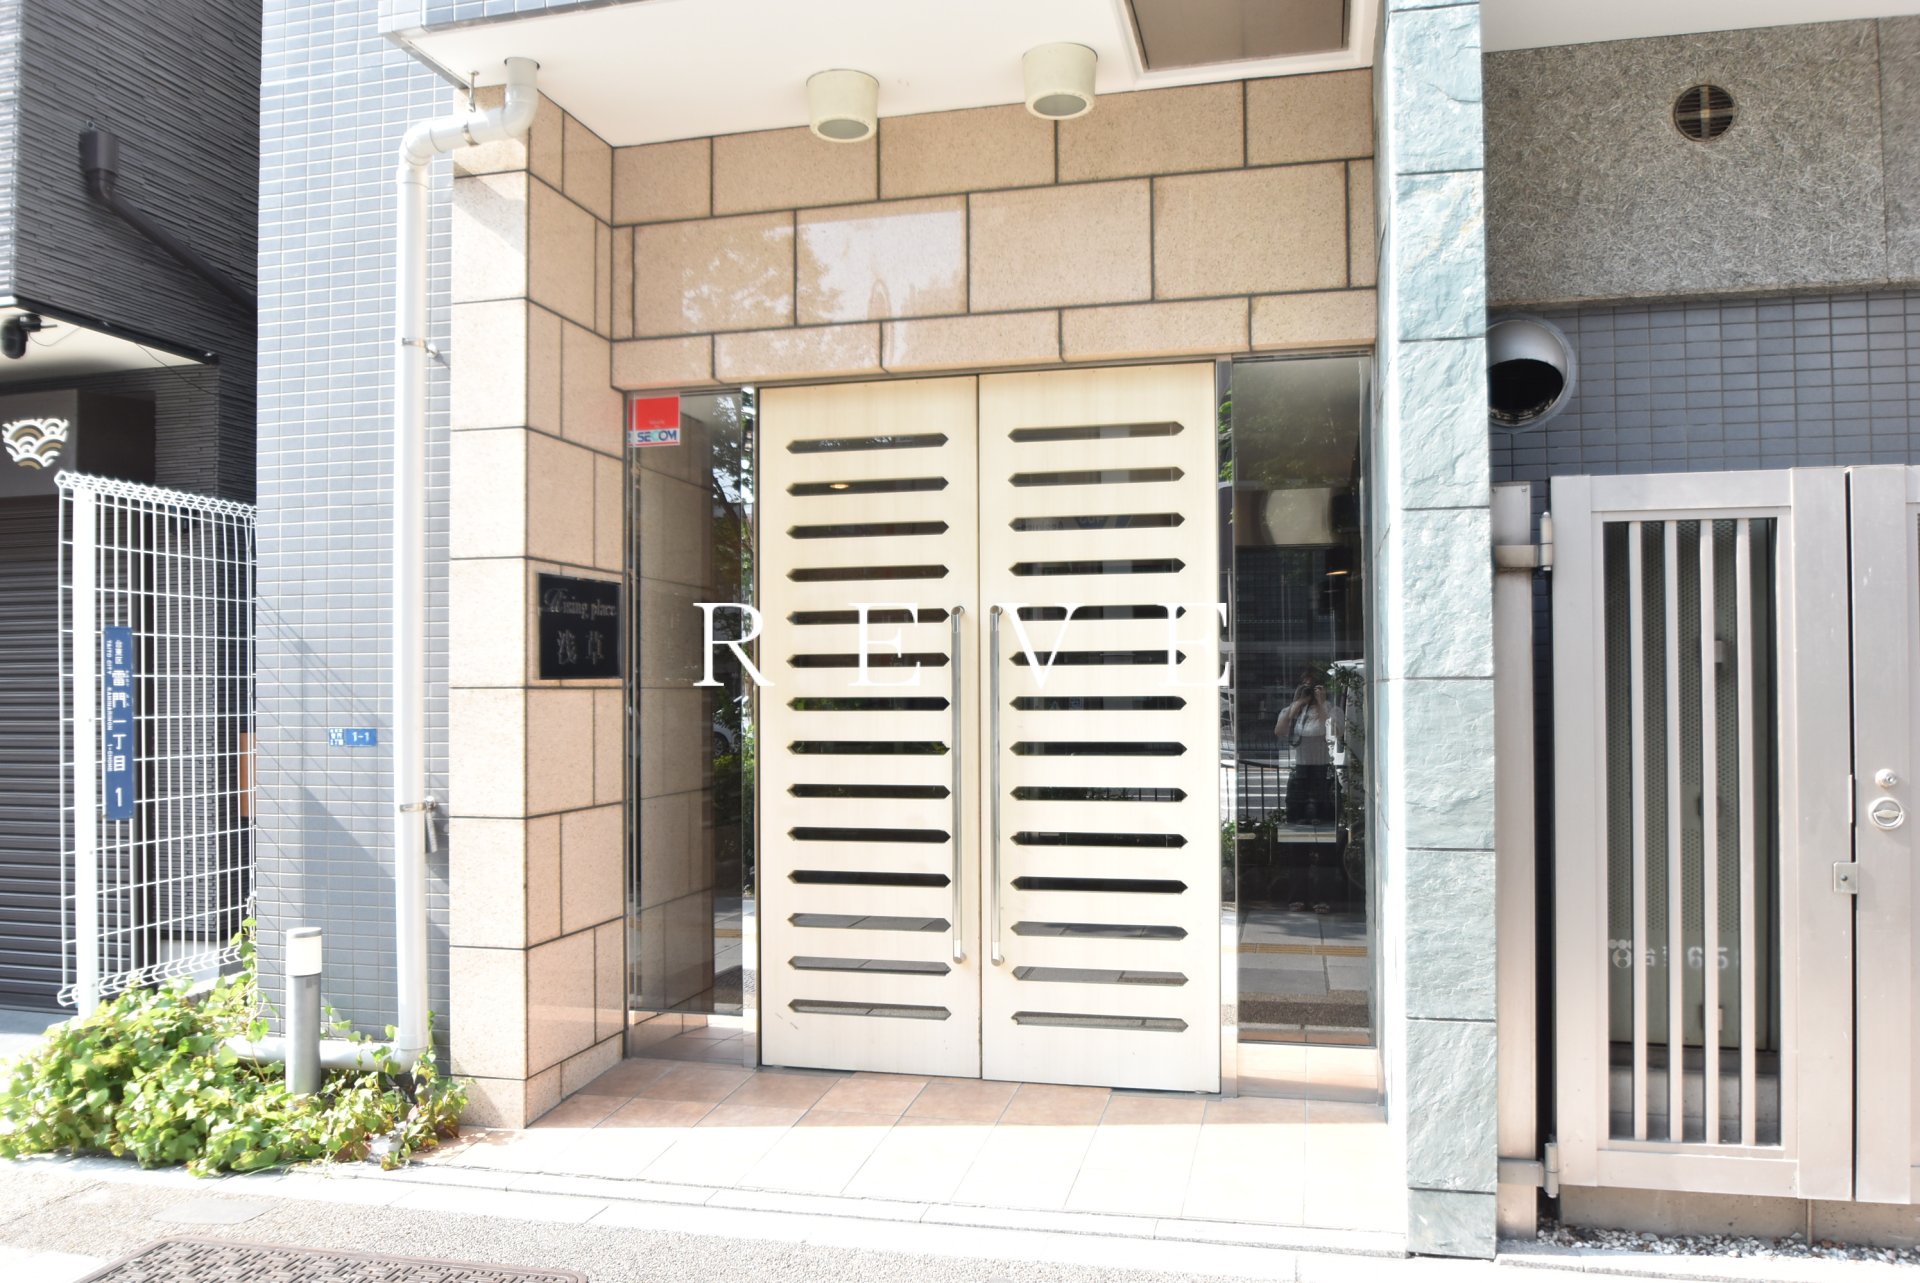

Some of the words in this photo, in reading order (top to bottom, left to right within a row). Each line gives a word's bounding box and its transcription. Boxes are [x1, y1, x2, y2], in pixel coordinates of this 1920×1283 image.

[637, 430, 677, 443] SECOM
[590, 598, 618, 621] place
[112, 669, 126, 772] 雷門一丁目
[352, 731, 369, 742] 1-1
[115, 787, 122, 807] 1
